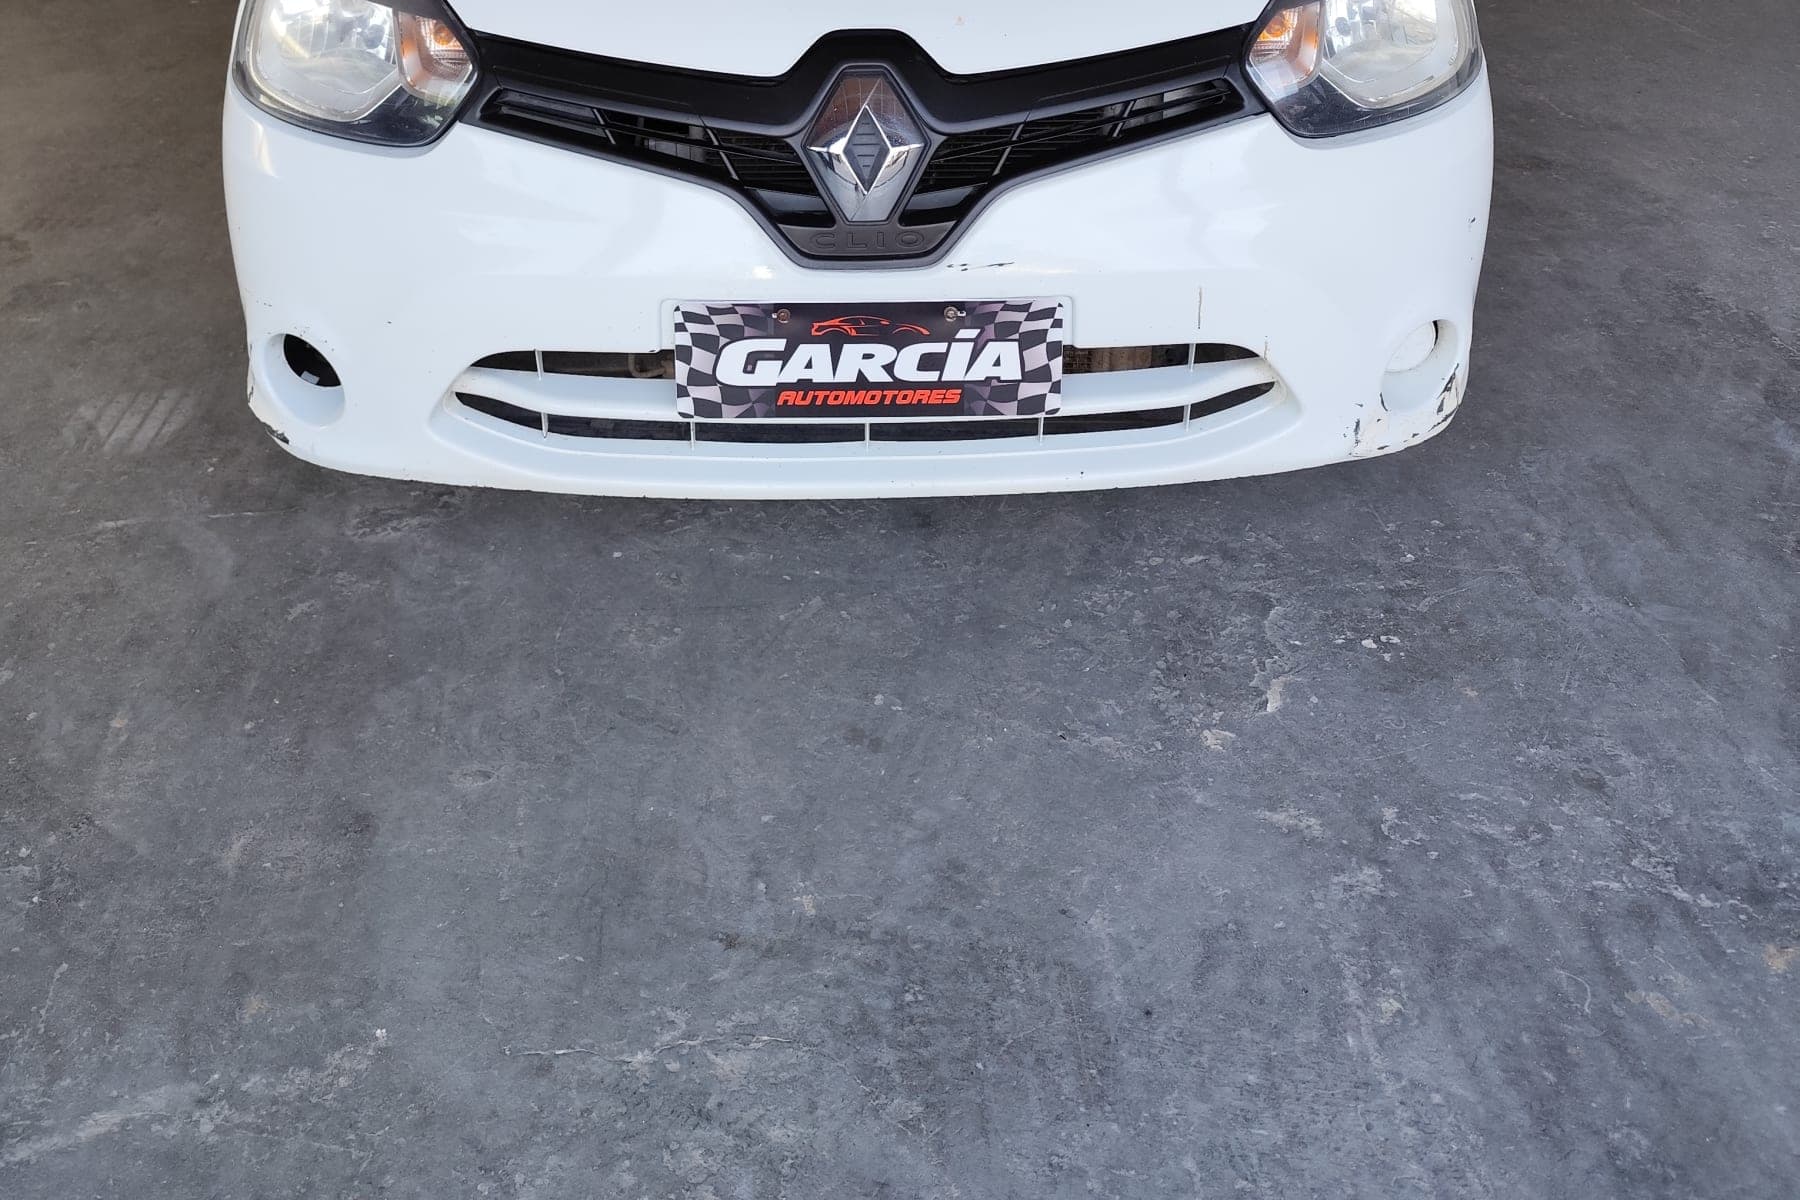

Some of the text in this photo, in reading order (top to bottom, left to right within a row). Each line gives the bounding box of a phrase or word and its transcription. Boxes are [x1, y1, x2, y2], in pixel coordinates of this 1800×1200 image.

[809, 230, 925, 249] CLIO
[715, 328, 1023, 387] GARCÍA
[776, 388, 962, 406] AUTOMOTORES
